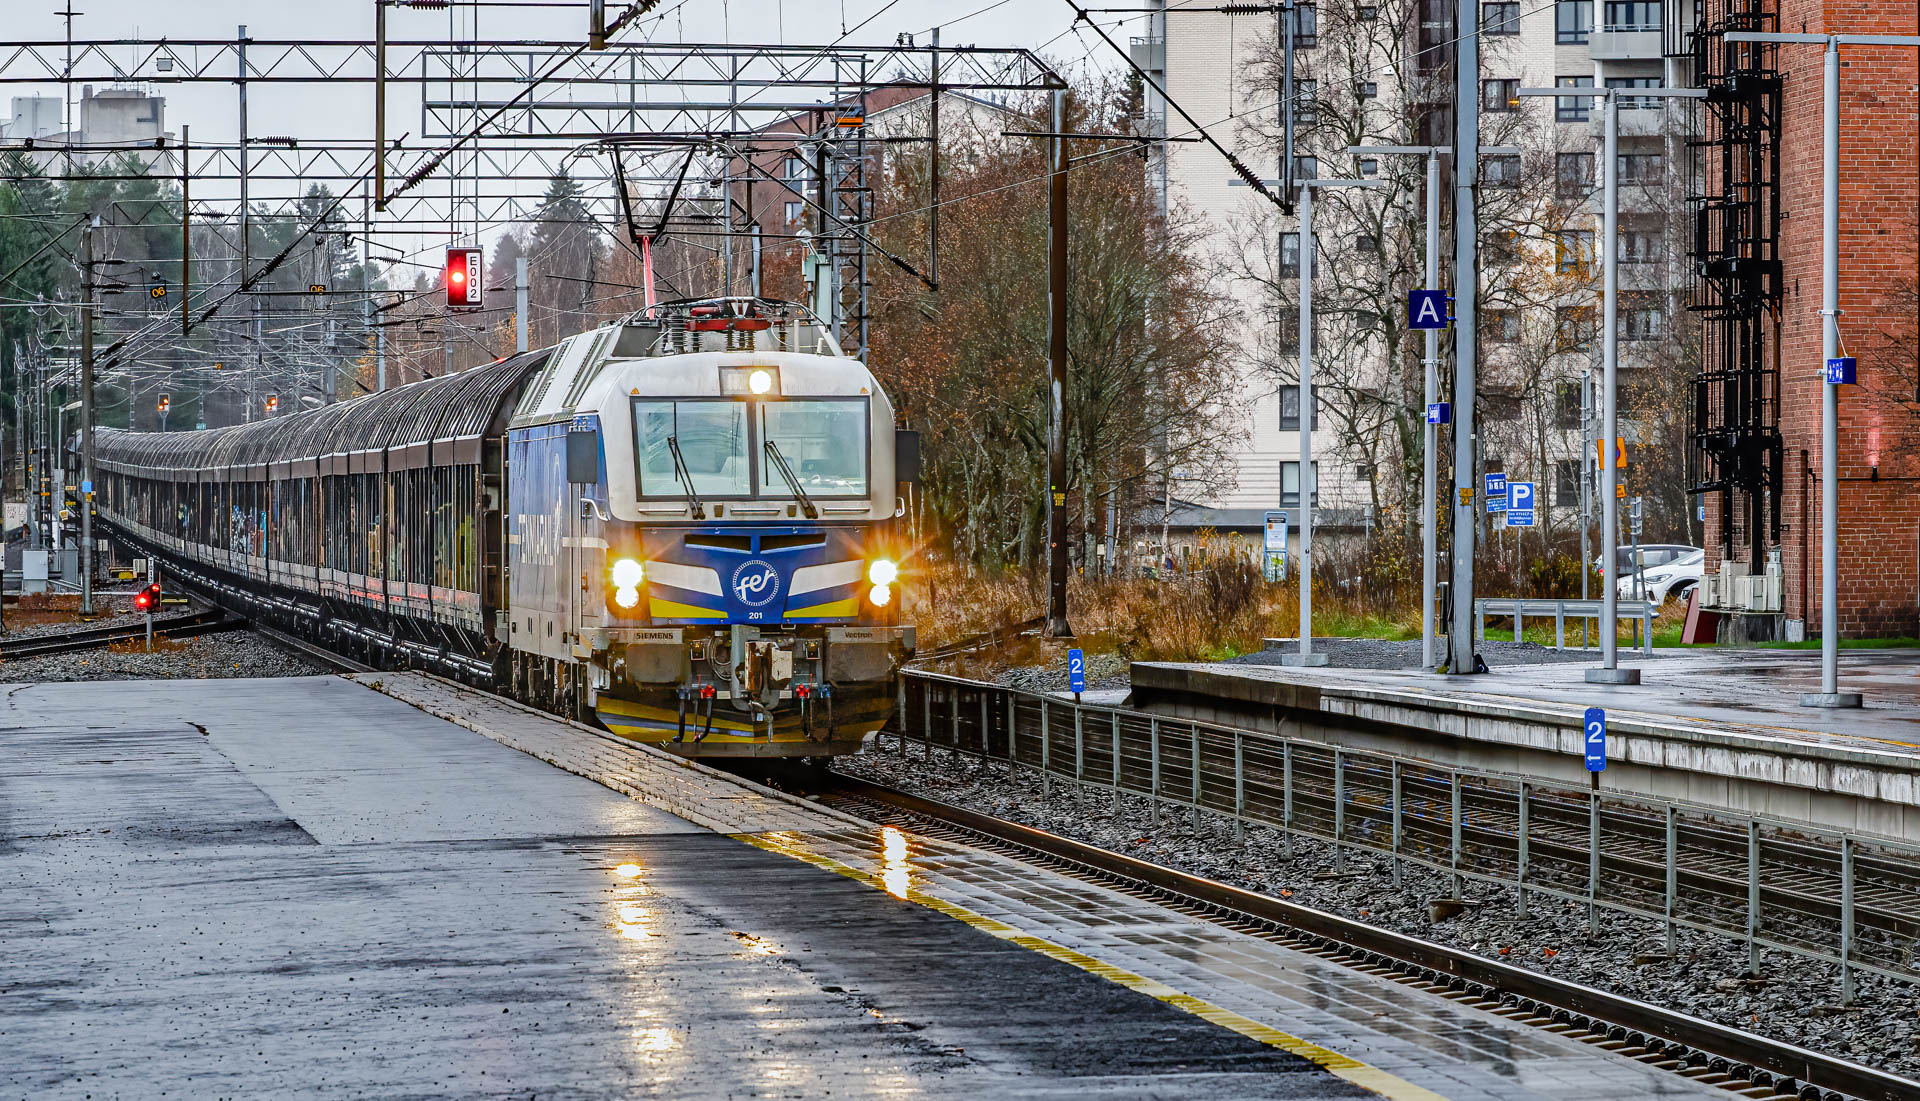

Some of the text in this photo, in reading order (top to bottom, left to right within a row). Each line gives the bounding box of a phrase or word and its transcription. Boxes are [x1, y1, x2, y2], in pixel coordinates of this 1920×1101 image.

[470, 256, 478, 299] E002
[151, 286, 166, 298] 06
[1416, 296, 1440, 323] A
[1512, 484, 1531, 508] P
[735, 569, 775, 602] fer
[748, 611, 763, 620] 201
[636, 632, 674, 640] SIEMENS
[844, 631, 873, 639] Vectron
[1071, 658, 1082, 674] 2
[1588, 721, 1603, 743] 2
